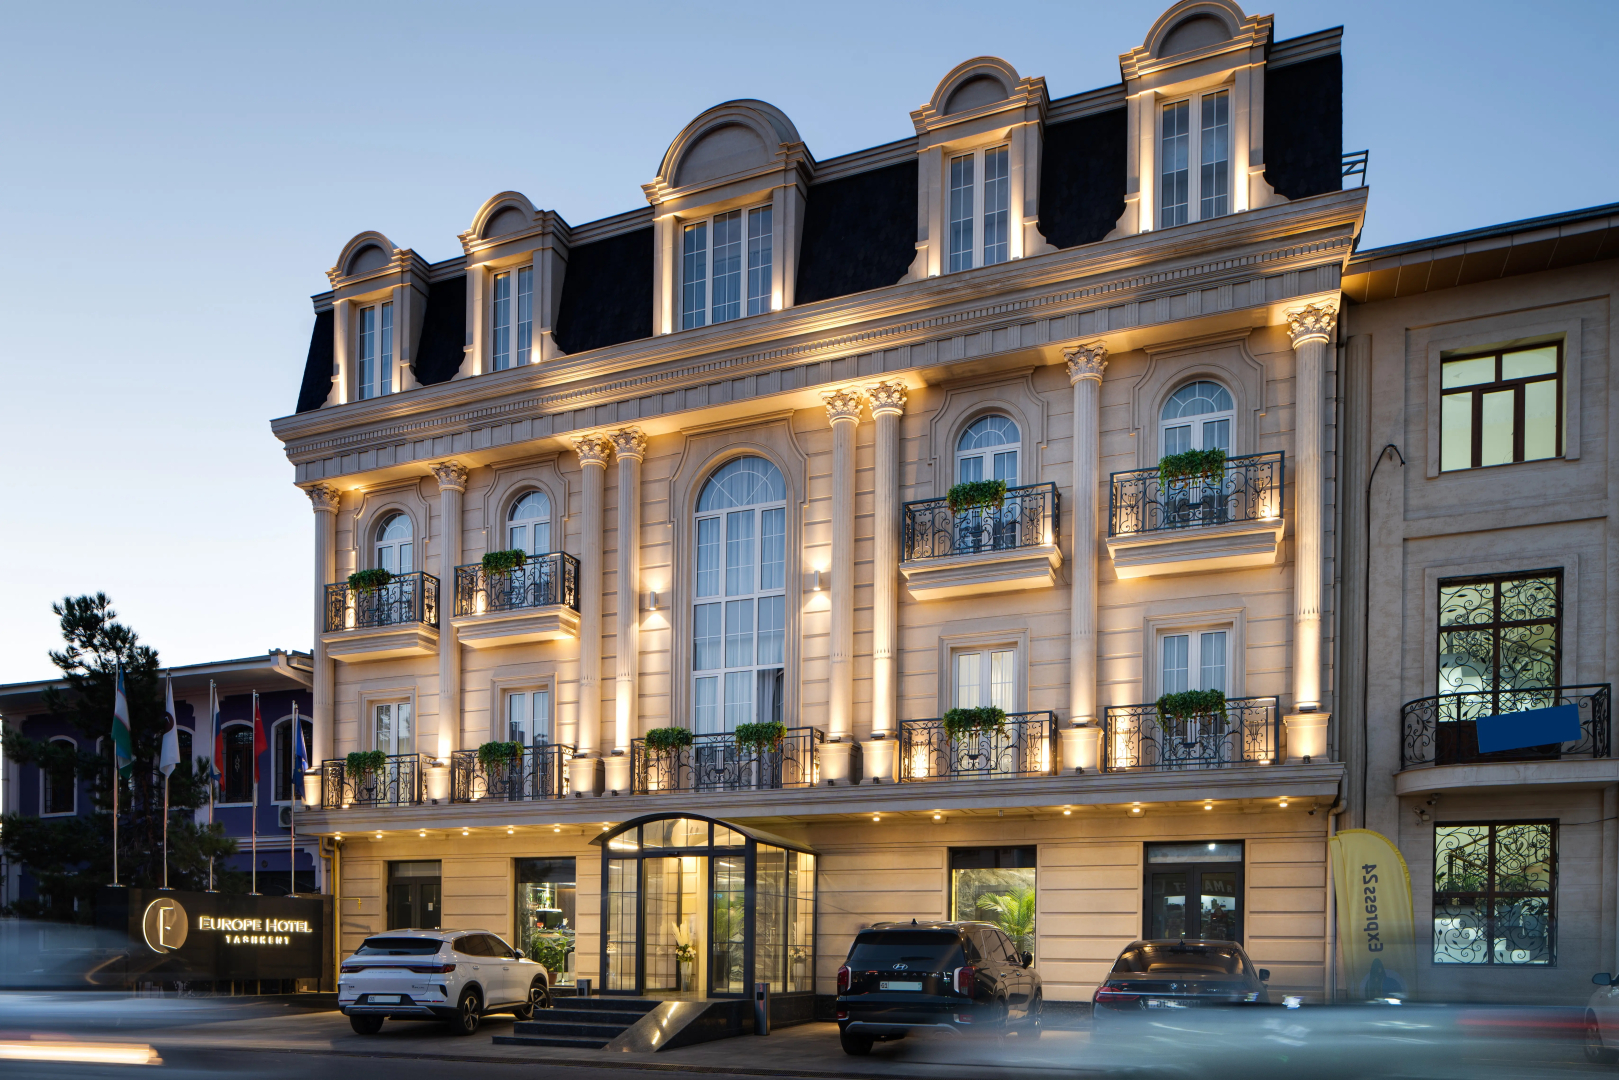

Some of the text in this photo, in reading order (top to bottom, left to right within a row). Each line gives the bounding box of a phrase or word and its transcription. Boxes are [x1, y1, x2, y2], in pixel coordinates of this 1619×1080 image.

[199, 915, 313, 933] EUROPE HOTEL
[225, 934, 290, 945] TASHKENT
